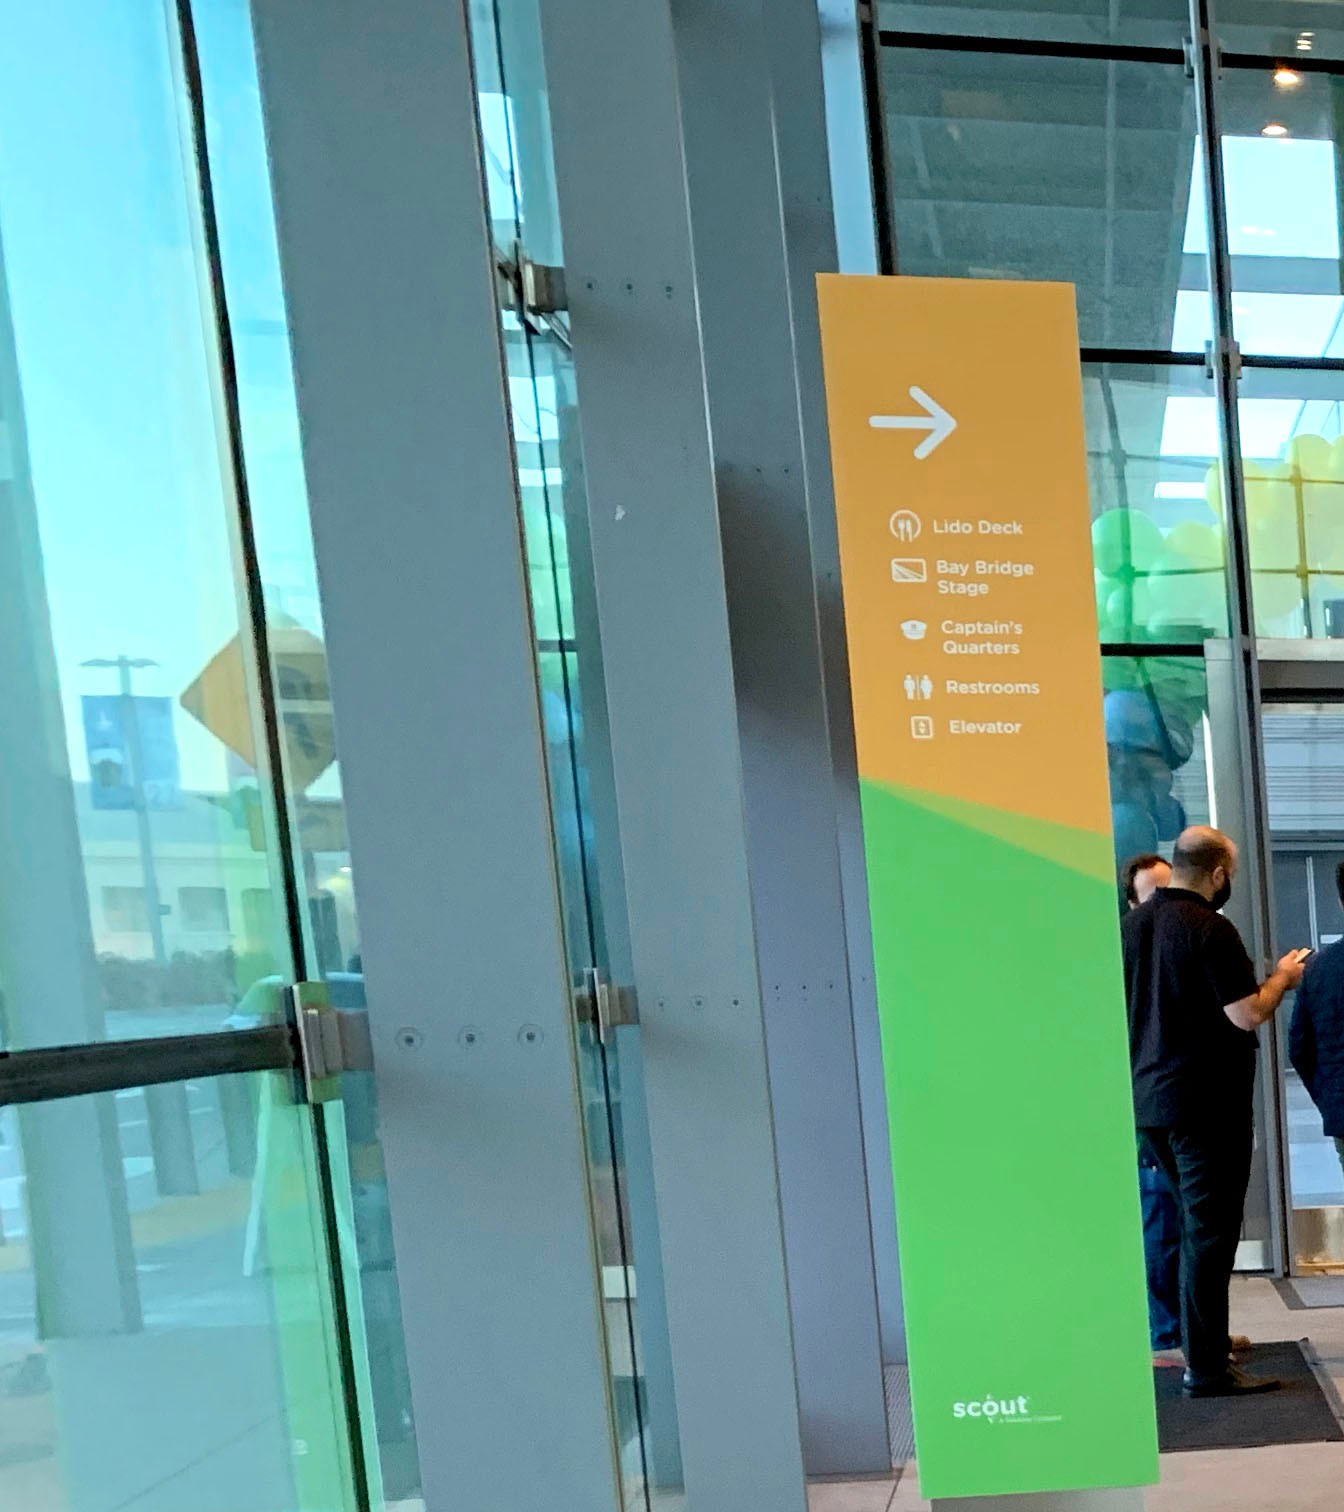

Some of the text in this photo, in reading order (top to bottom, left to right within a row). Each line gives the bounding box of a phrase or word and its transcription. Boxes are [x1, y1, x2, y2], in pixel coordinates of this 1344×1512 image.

[933, 519, 1023, 535] Lido Deck
[936, 560, 1034, 577] Bay Bridge
[938, 580, 989, 596] Stage
[941, 620, 1023, 636] Captain's
[943, 641, 1020, 656] Quarters
[946, 680, 1040, 695] Restrooms
[950, 720, 1022, 735] Elevator
[953, 1394, 1029, 1419] scout
